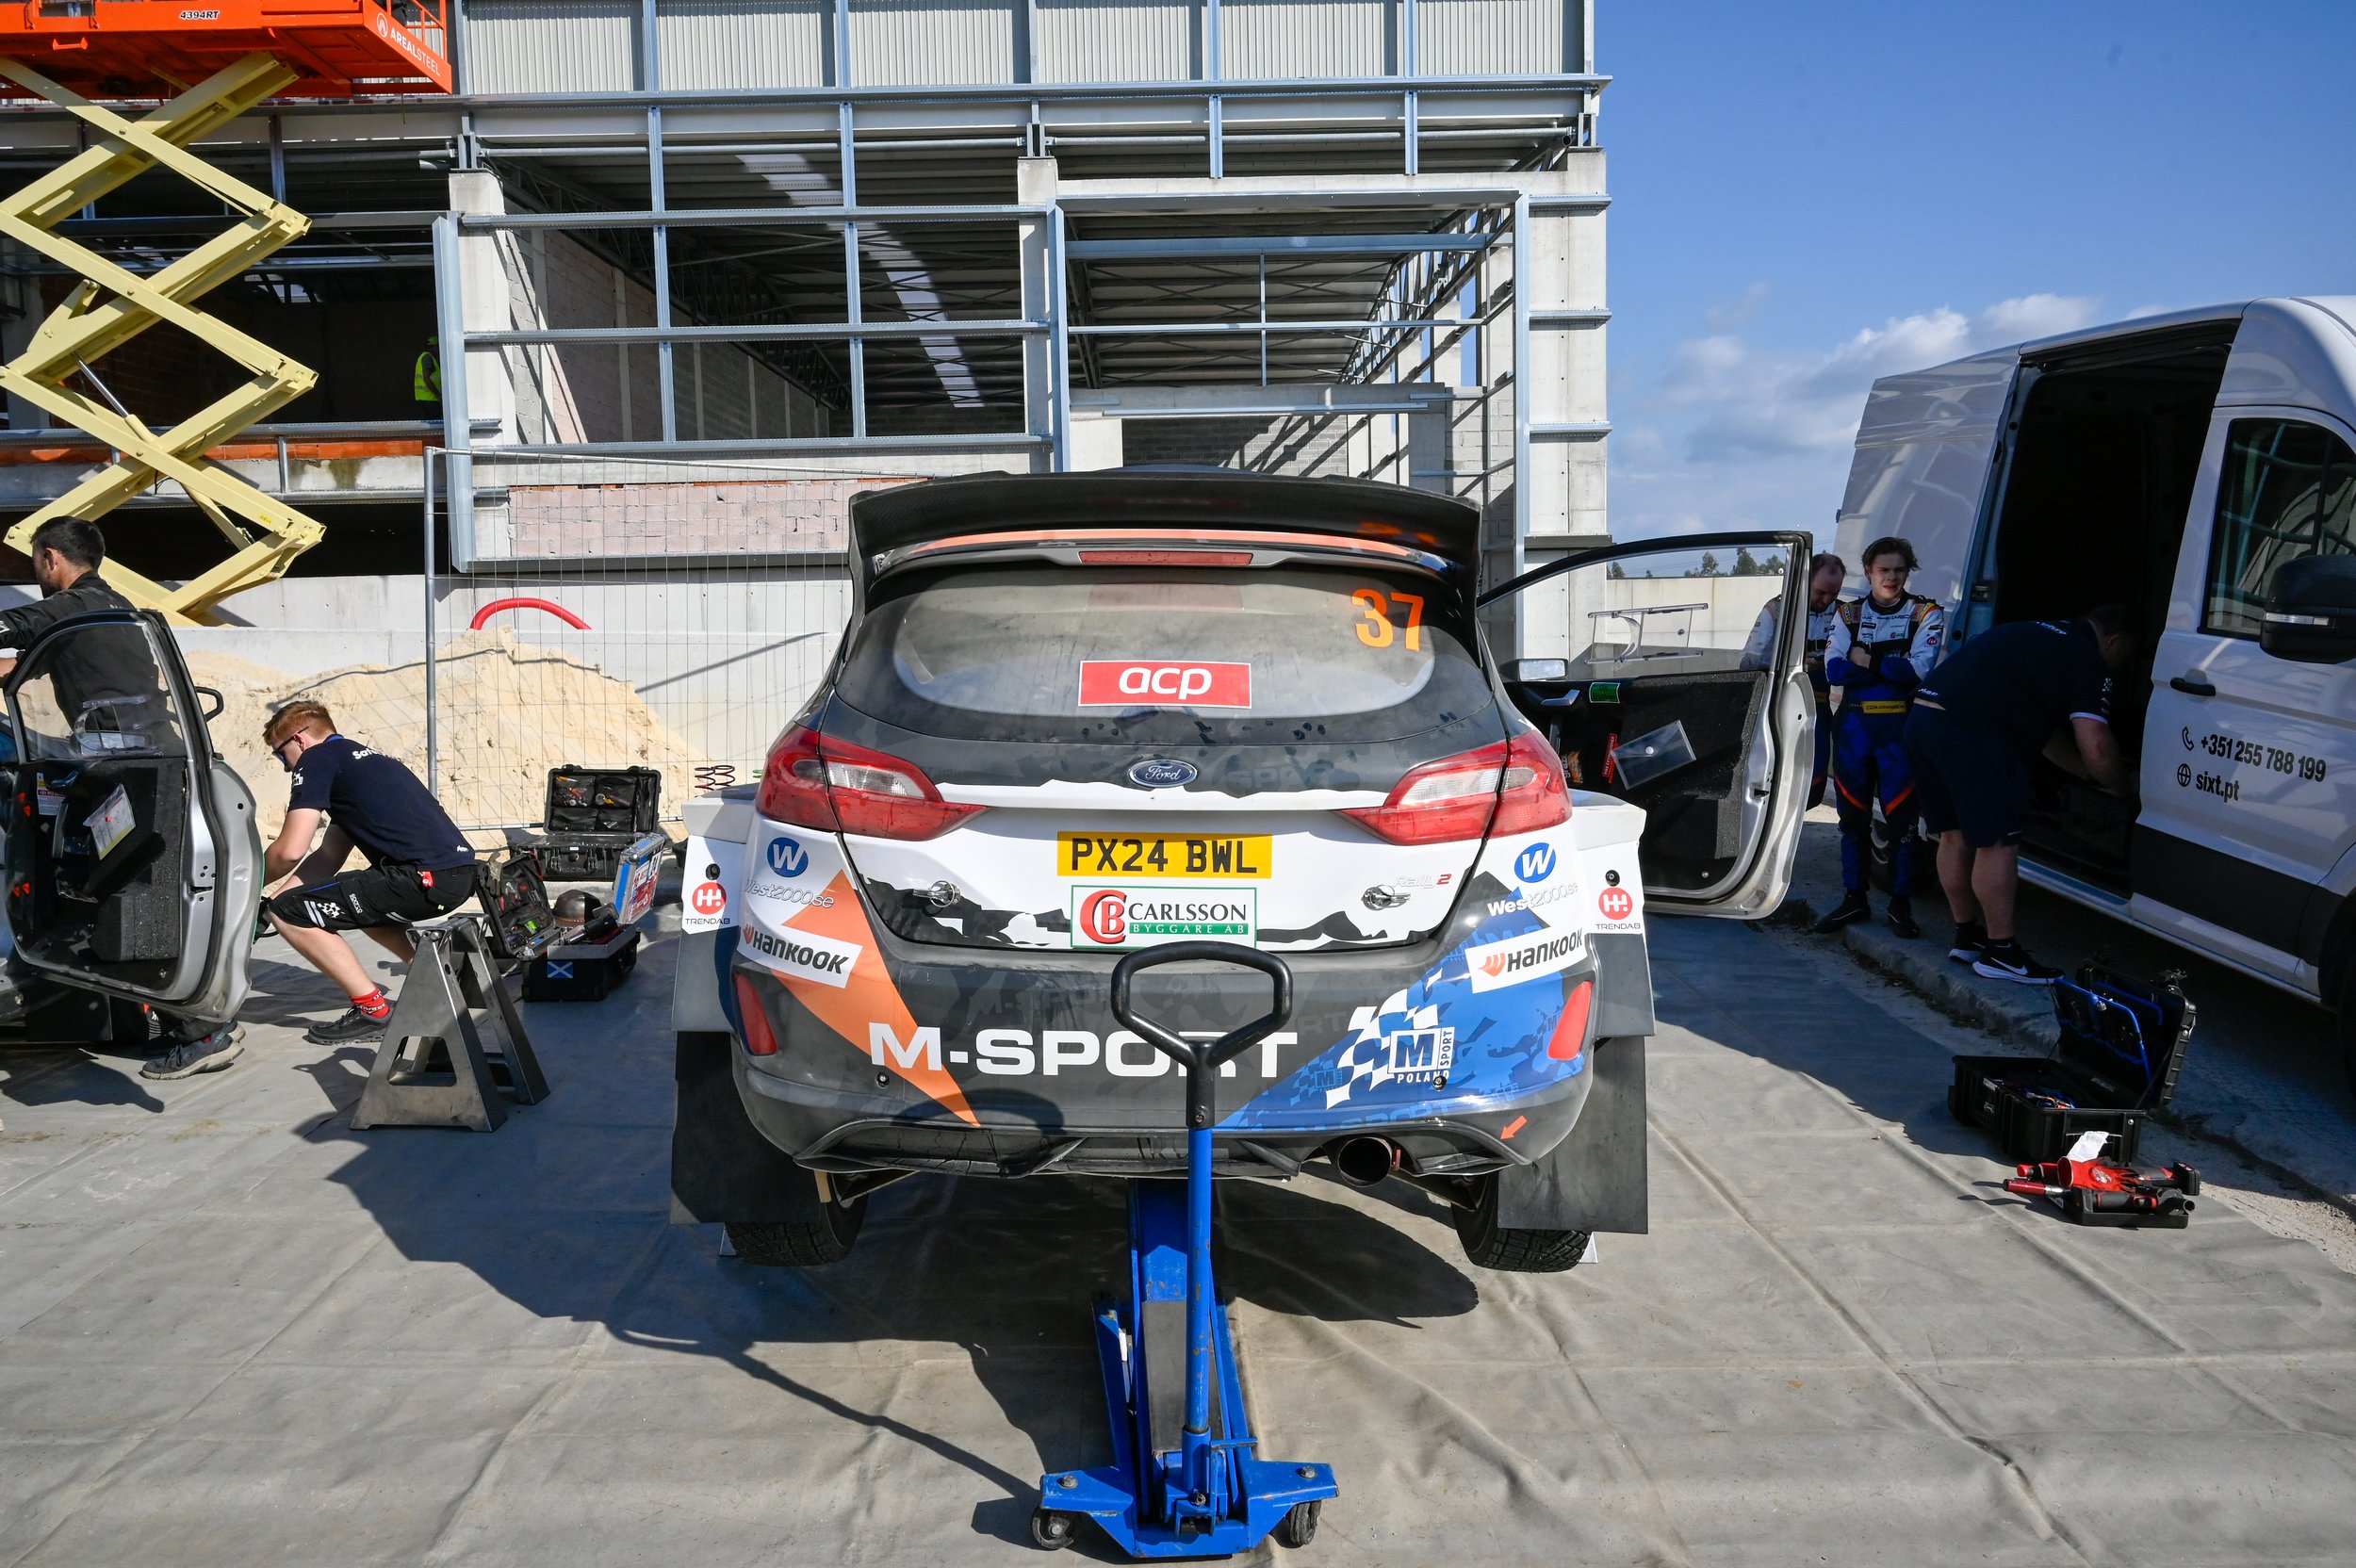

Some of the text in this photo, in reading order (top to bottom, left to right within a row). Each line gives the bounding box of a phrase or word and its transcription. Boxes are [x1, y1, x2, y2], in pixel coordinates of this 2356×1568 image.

[180, 9, 220, 20] 4394RT
[390, 27, 440, 76] AREALSTEEL
[1351, 588, 1424, 651] 37
[1118, 666, 1213, 700] acp
[1145, 764, 1182, 780] Ford
[2201, 734, 2326, 782] +351 255 788 199
[2196, 771, 2240, 803] sixt.pt
[773, 841, 808, 872] W
[1072, 837, 1257, 874] PX24 BWL
[1521, 845, 1555, 878] W
[1128, 903, 1247, 921] CARLSSON
[1133, 923, 1244, 933] BYGGARE AB
[1394, 1031, 1453, 1069] M SPORT
